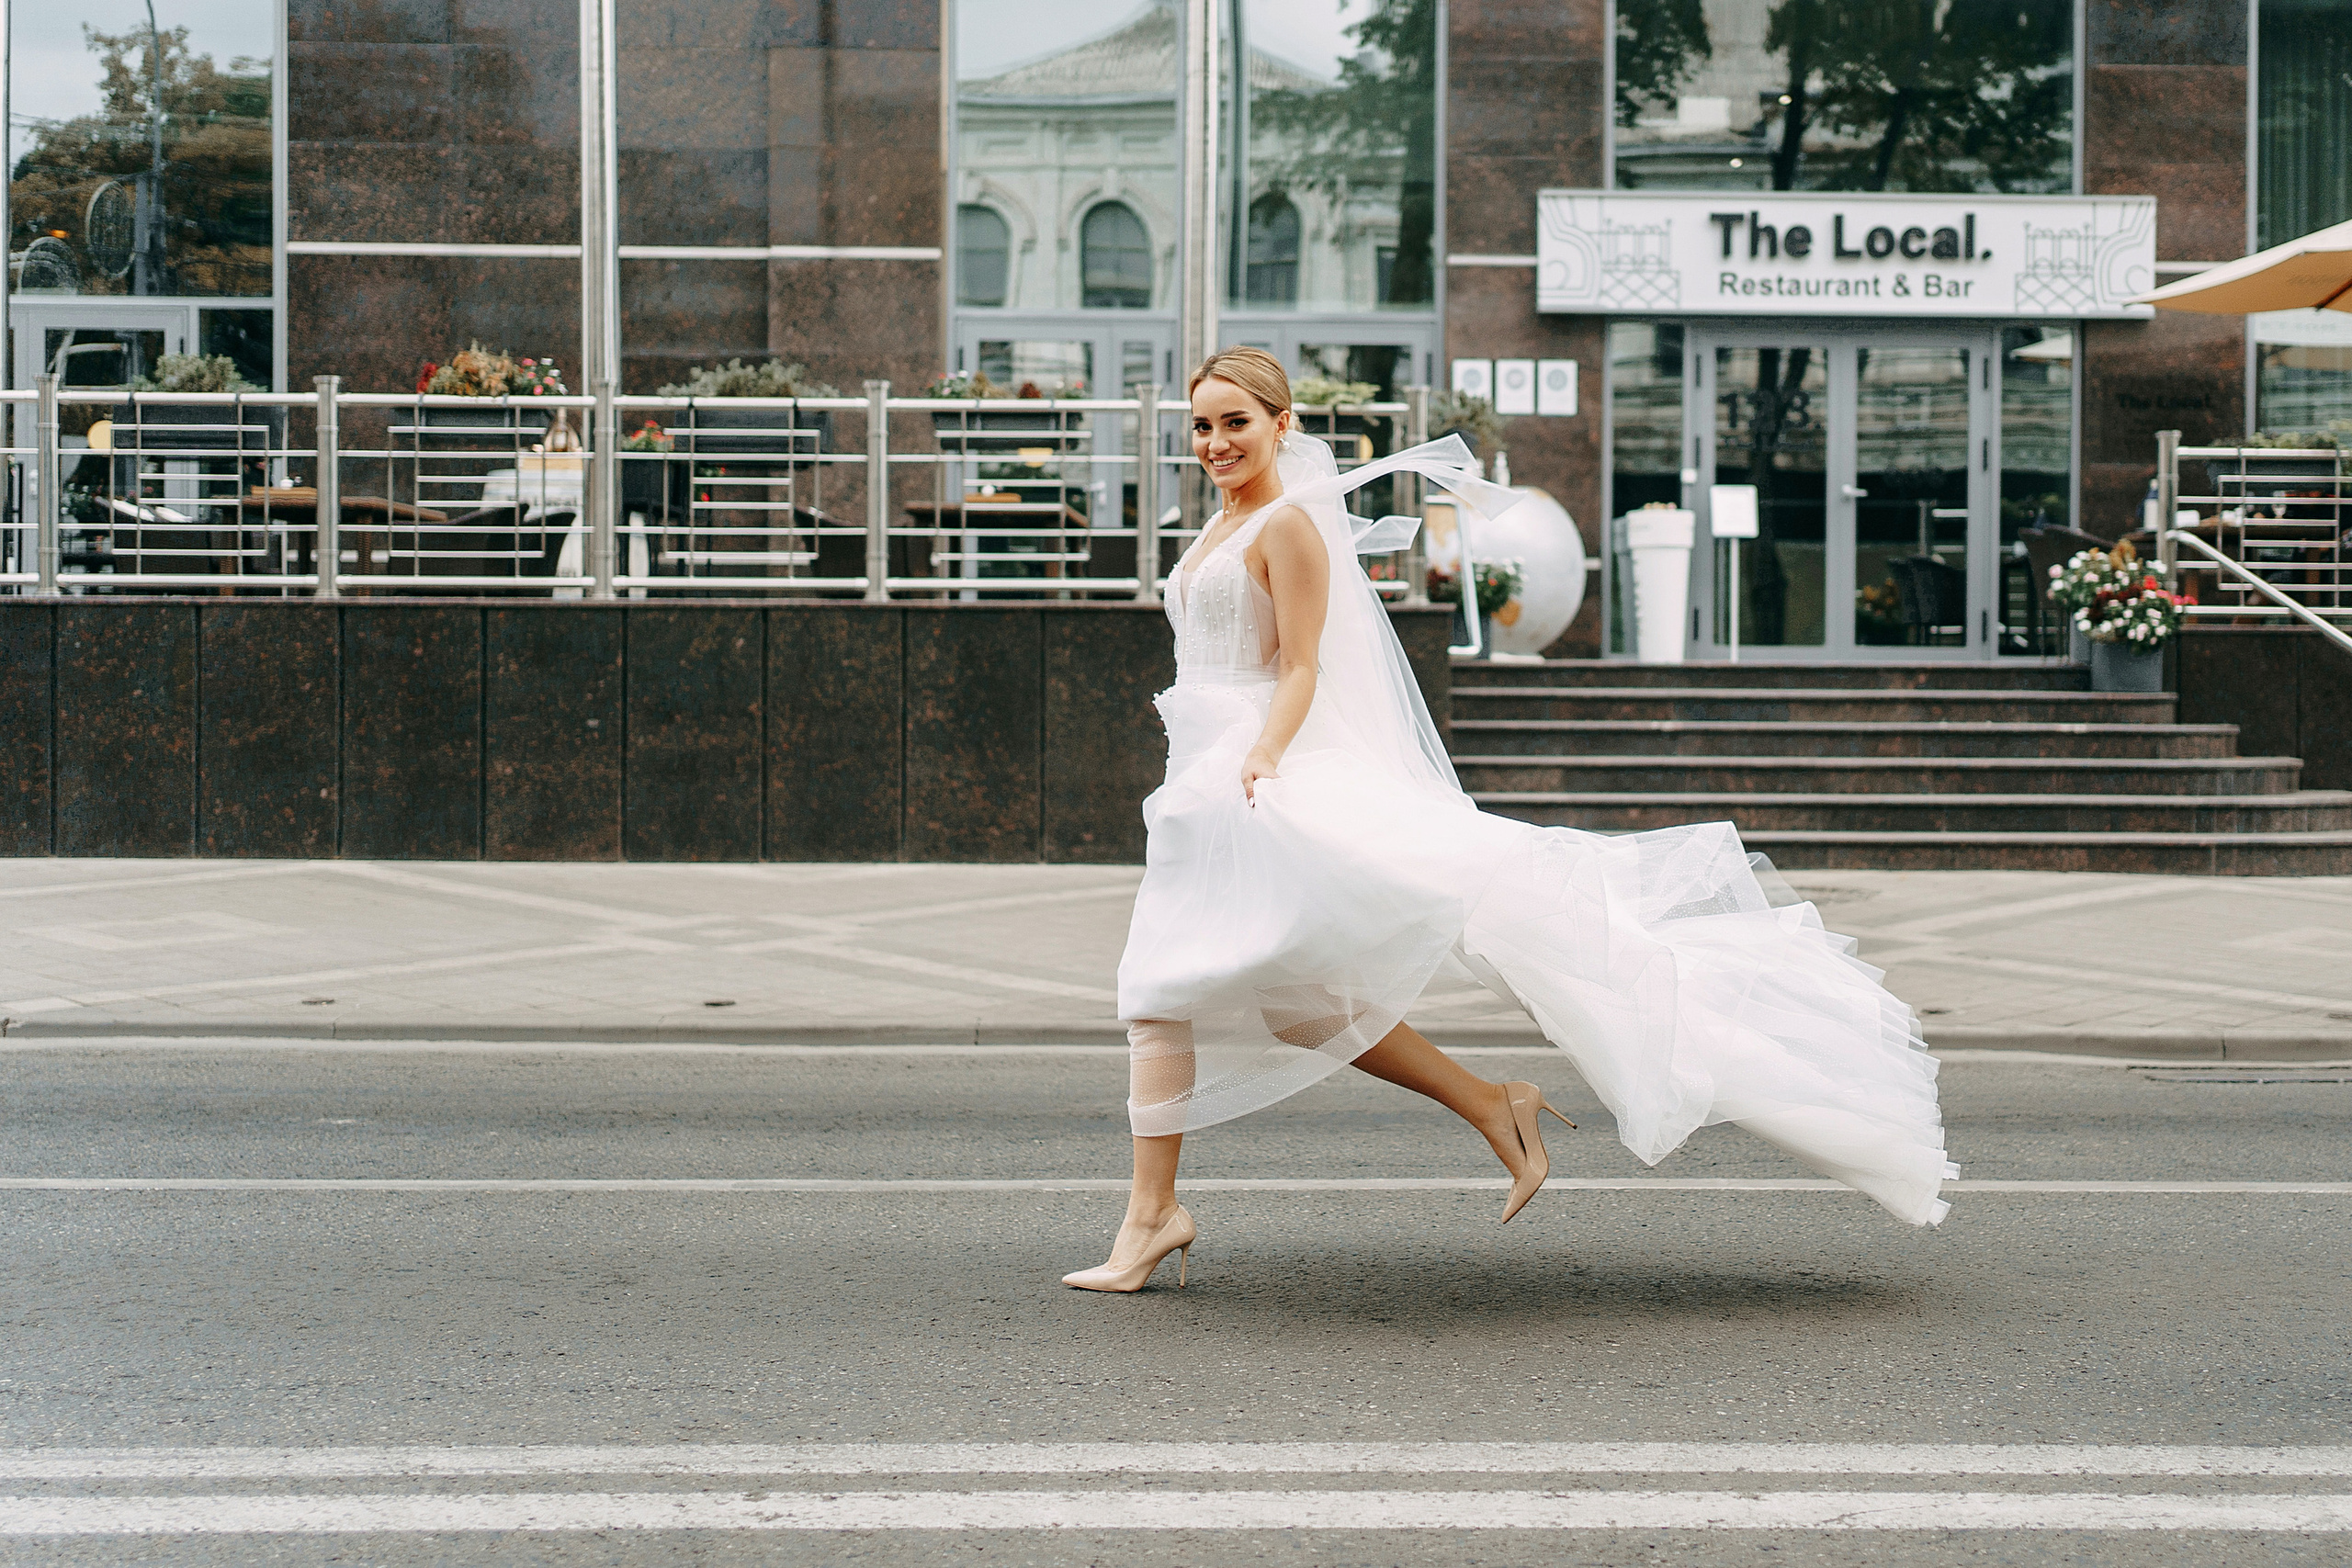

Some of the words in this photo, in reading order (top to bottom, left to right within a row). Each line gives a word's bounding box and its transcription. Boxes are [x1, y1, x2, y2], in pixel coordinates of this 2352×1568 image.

[1710, 210, 1813, 258] The
[1834, 212, 1992, 259] Local.
[1719, 272, 1880, 296] Restaurant
[1893, 274, 1911, 297] &
[1924, 274, 1974, 297] Bar
